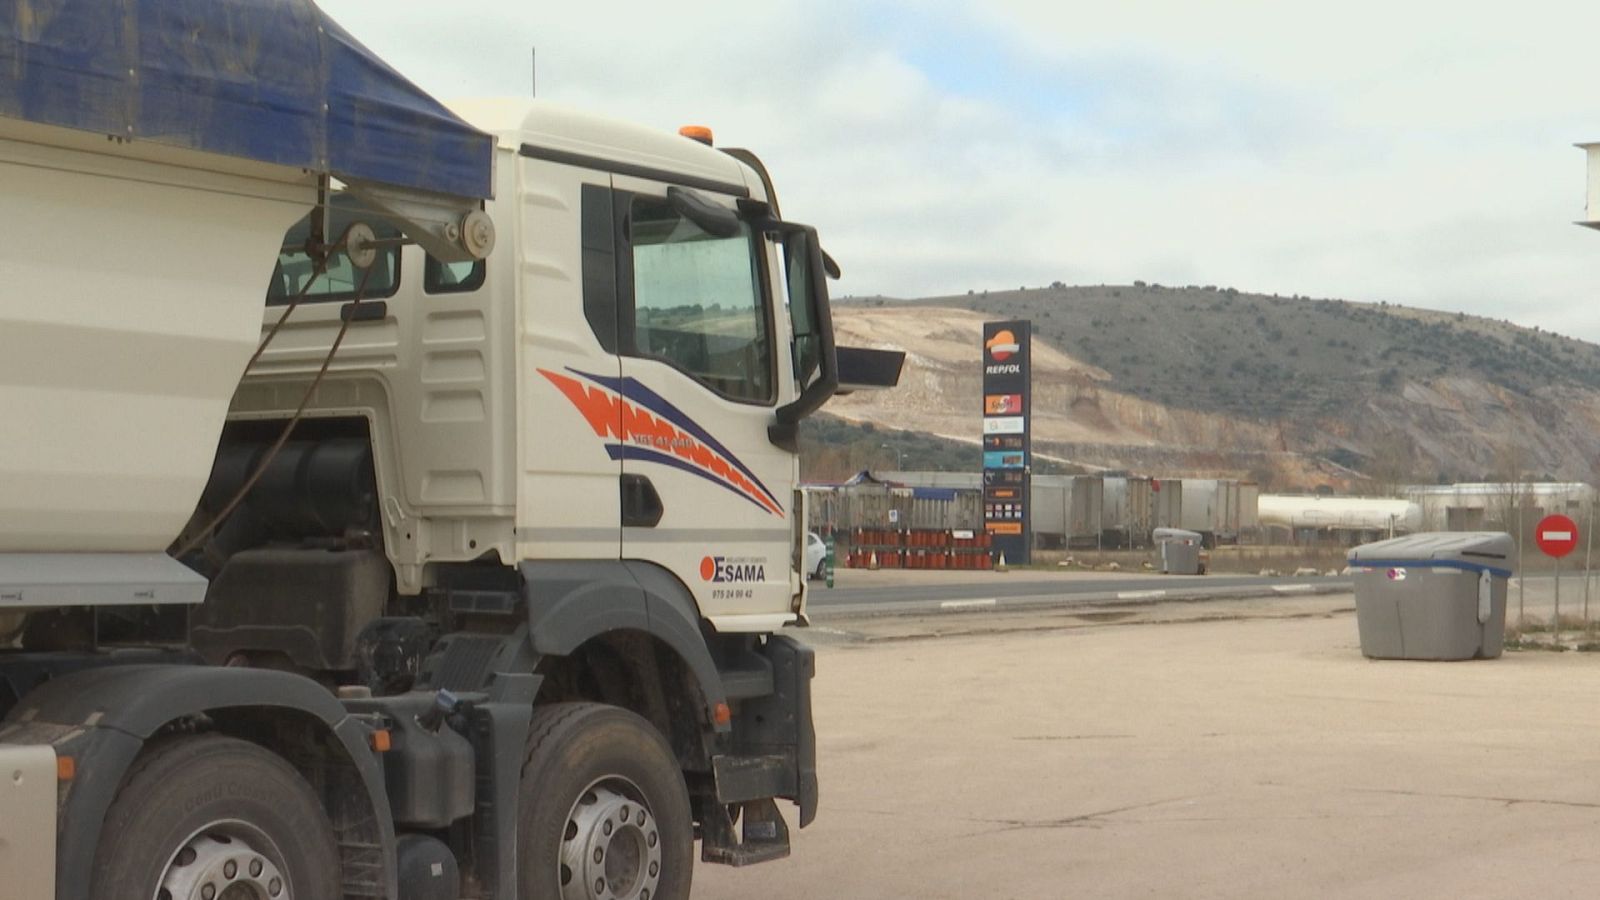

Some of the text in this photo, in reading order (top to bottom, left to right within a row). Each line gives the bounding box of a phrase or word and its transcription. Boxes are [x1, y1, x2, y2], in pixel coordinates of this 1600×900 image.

[986, 364, 1020, 375] REPSOL
[712, 556, 766, 582] ESAMA
[726, 589, 734, 599] 24
[745, 588, 753, 598] 42
